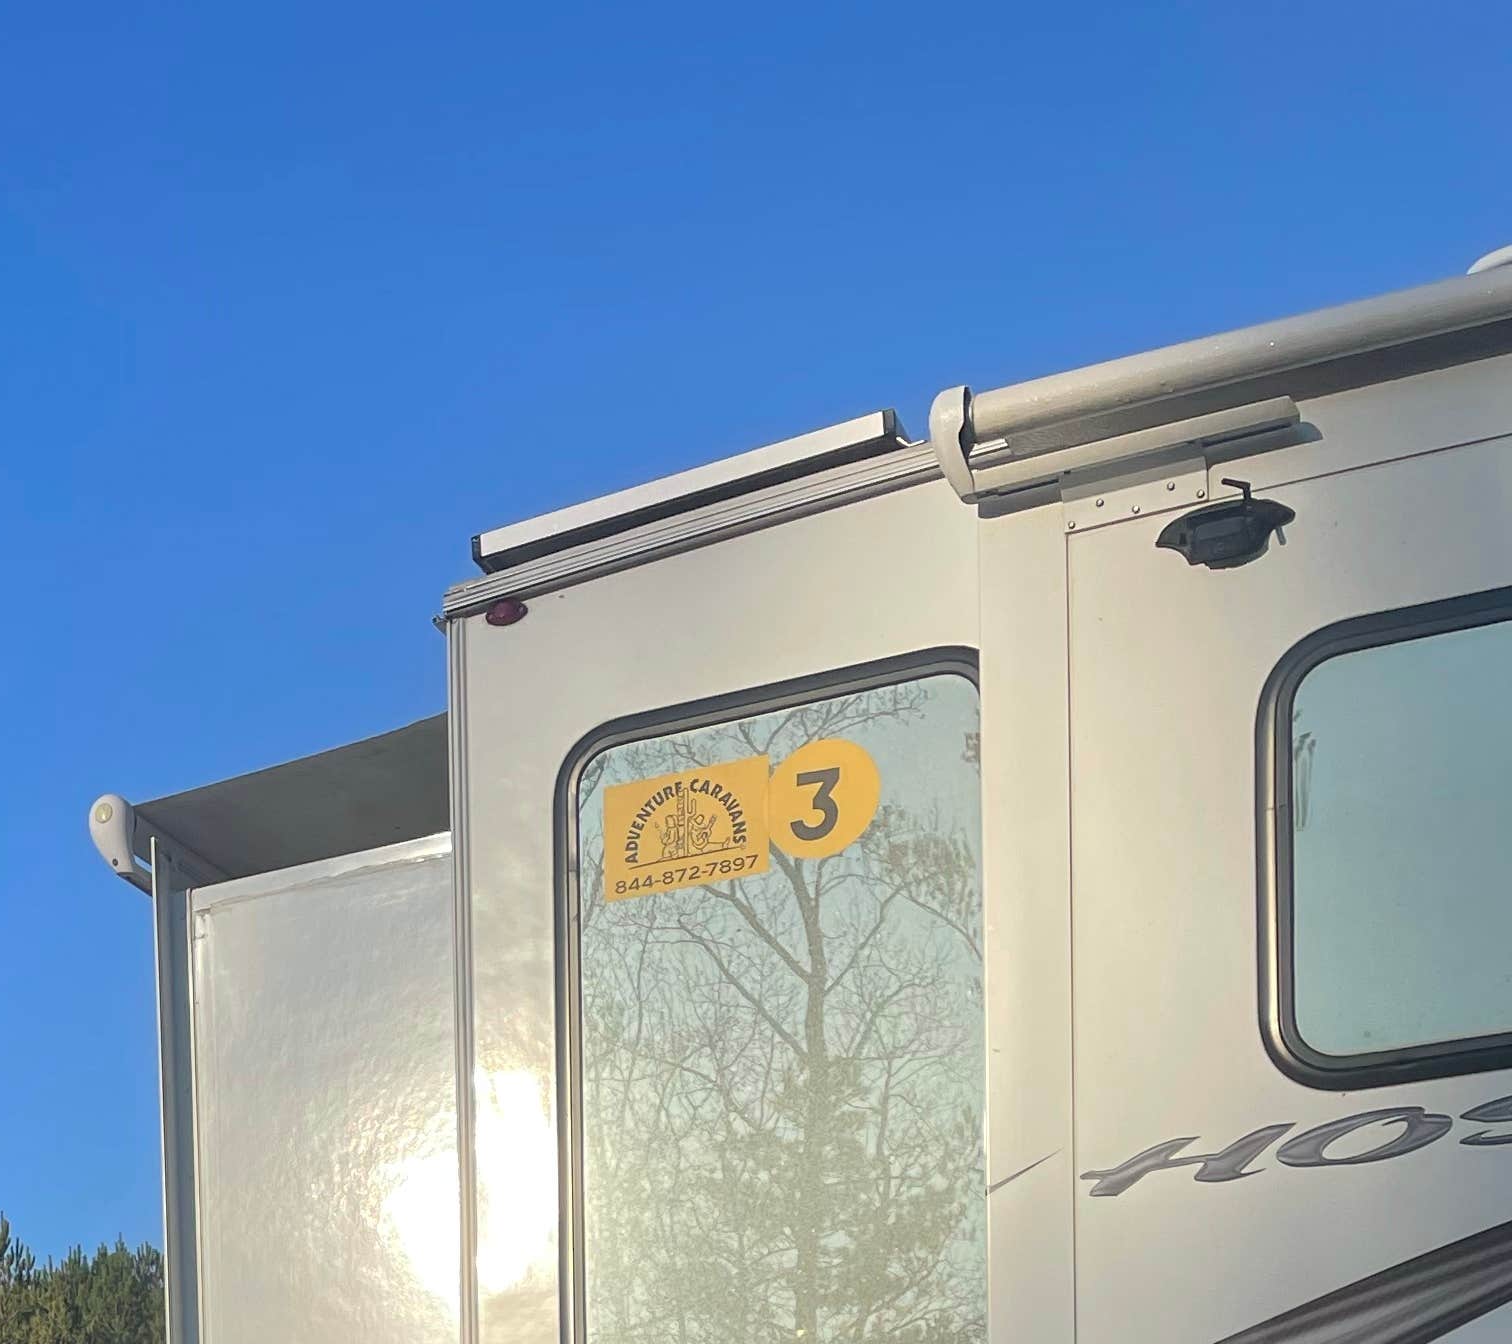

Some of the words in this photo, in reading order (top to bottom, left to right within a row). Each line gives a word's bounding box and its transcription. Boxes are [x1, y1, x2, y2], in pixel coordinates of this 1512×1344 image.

[625, 781, 683, 863] ADVENTURE
[690, 779, 746, 843] CARAVANS
[790, 767, 840, 841] 3
[615, 855, 758, 894] 844-872-7897
